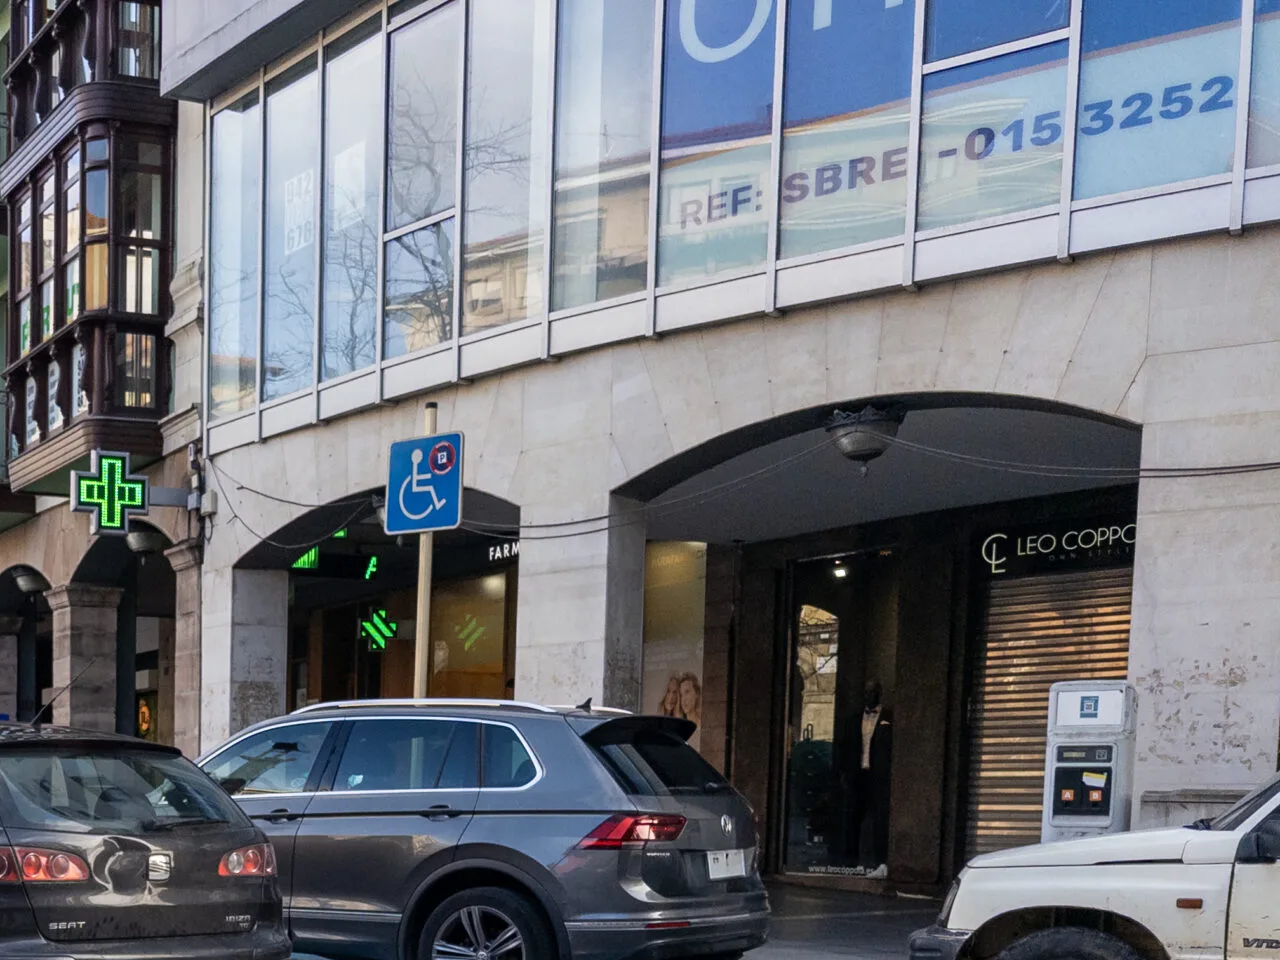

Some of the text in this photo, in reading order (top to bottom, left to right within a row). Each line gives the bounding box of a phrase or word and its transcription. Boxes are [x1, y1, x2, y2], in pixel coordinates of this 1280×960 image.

[680, 183, 763, 230] REF:
[1017, 534, 1056, 556] LEO
[49, 921, 86, 930] SEAT
